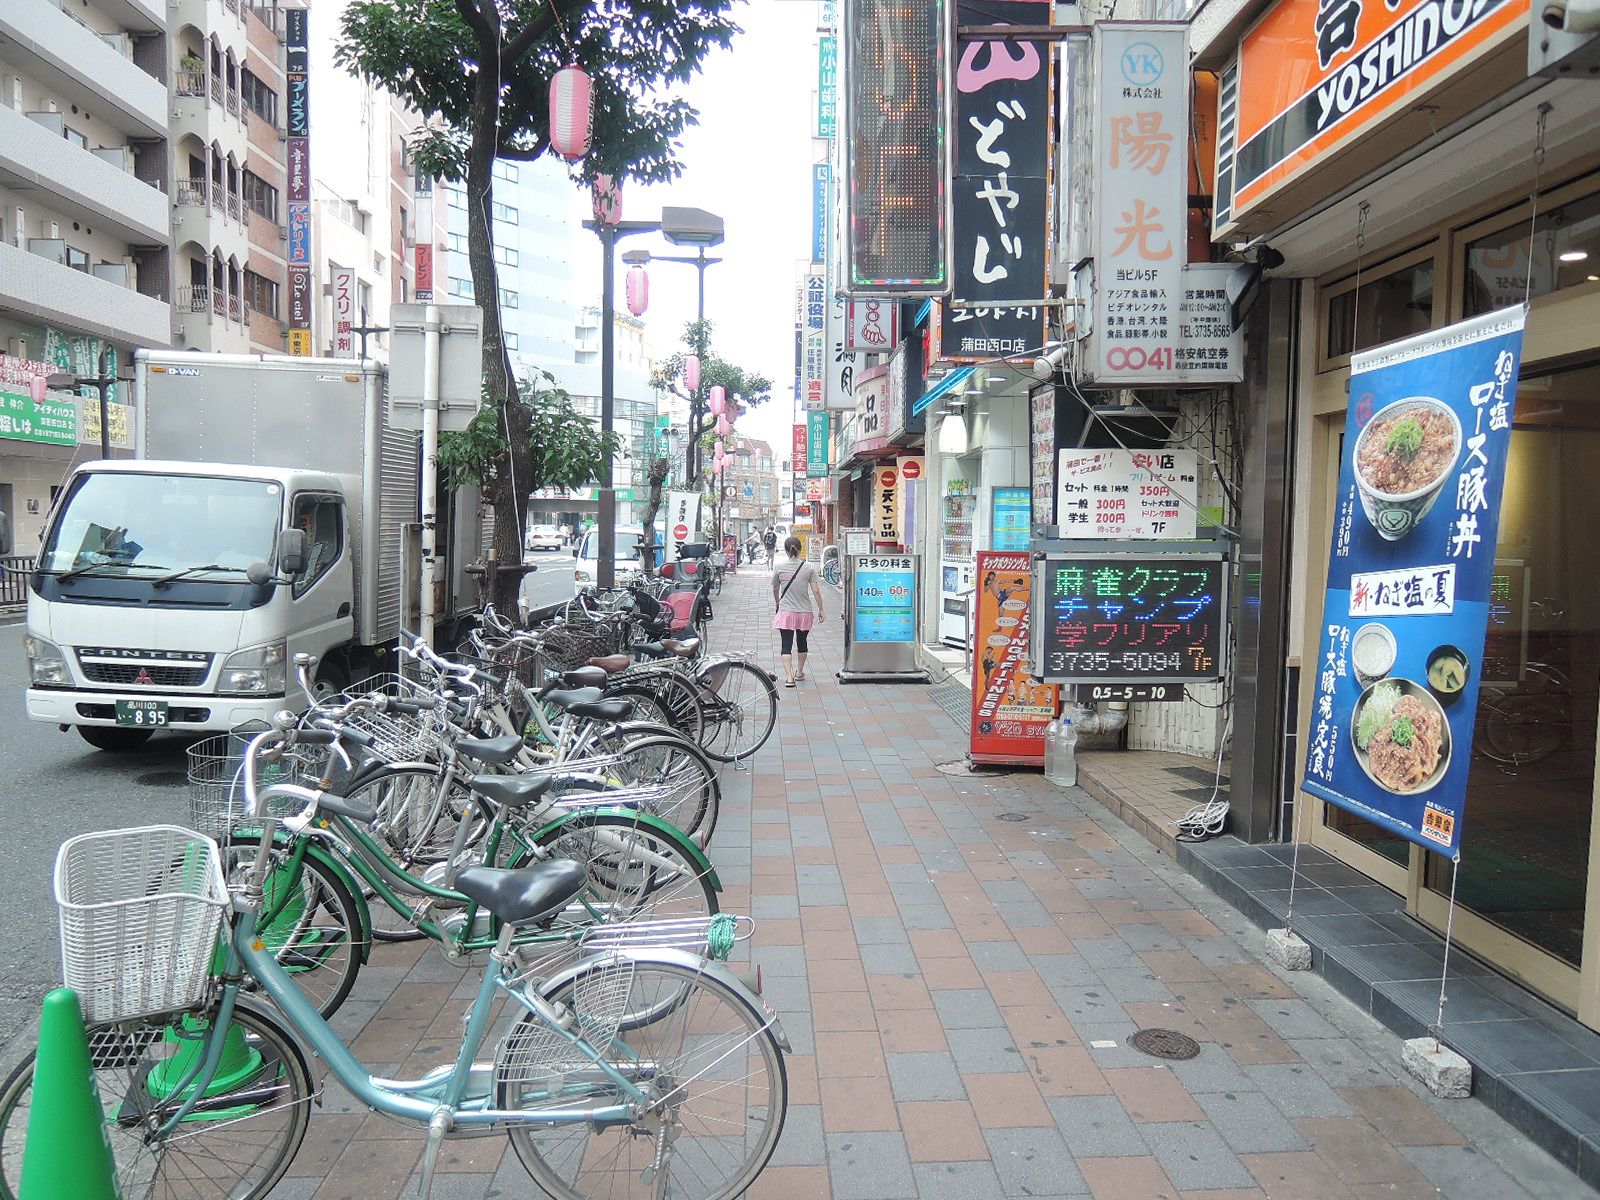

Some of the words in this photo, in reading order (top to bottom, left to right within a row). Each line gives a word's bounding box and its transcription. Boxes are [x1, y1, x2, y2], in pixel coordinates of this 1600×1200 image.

[1125, 54, 1161, 73] YK
[1123, 87, 1163, 99] 株式会社
[292, 79, 307, 131] ブーメラン
[1110, 112, 1173, 261] 陽光
[1116, 269, 1158, 281] 当ビル5F
[1107, 289, 1168, 299] アジア食品輸入
[1185, 289, 1226, 300] 営業時間
[809, 277, 824, 329] 公証役場
[1107, 302, 1168, 312] ビデオレンタル
[961, 338, 1025, 352] 蒲田西口店
[1175, 347, 1229, 359] 格安航空券
[1488, 350, 1514, 432] ねぎ塩
[1452, 381, 1495, 558] ロース豚丼
[1180, 475, 1195, 483] 料金
[1065, 482, 1088, 493] セット
[1140, 486, 1170, 496] 350円
[1068, 499, 1088, 509] 一般
[1097, 499, 1125, 510] 300円
[881, 489, 896, 538] 天下一品
[1068, 513, 1089, 523] 学生
[1096, 513, 1125, 523] 200円
[1152, 522, 1166, 534] 7F
[859, 558, 911, 568] 只今の料金
[859, 587, 883, 597] 140円
[889, 586, 909, 595] 60円
[1055, 595, 1212, 619] チャンプ
[80, 648, 208, 660] CANTER
[1050, 652, 1181, 671] 3735-5094
[1188, 647, 1212, 671] 7F
